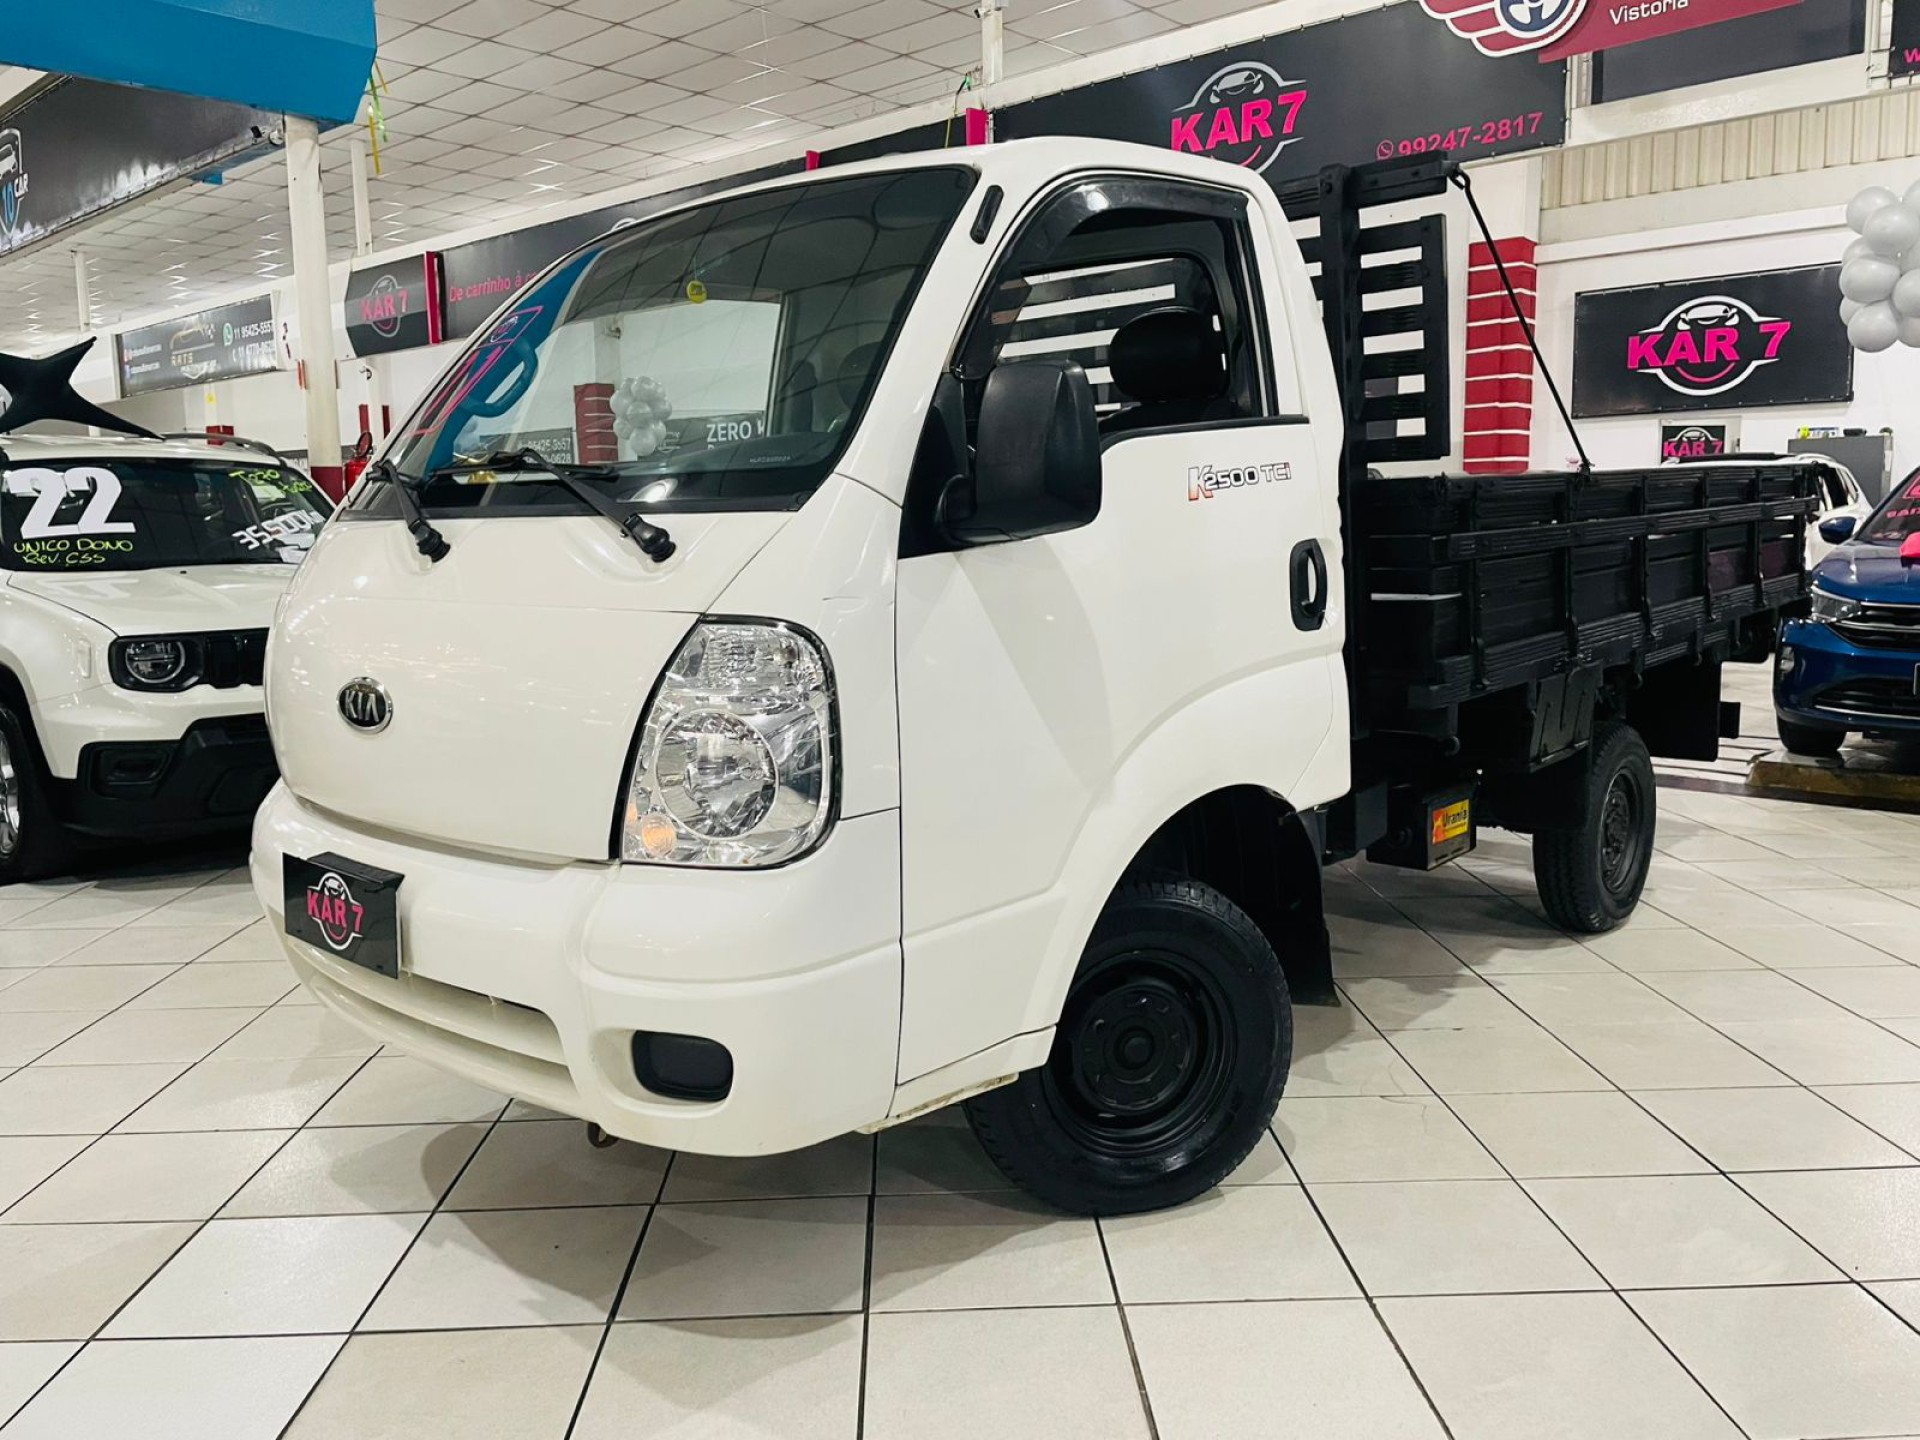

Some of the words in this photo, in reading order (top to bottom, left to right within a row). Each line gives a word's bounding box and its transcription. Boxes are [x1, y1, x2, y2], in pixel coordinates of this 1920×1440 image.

[1609, 0, 1689, 25] Vistoria
[1398, 112, 1543, 155] 99247-2817
[360, 293, 395, 320] KAR
[400, 289, 409, 312] 7
[450, 286, 463, 302] De
[467, 276, 511, 299] carrinho
[1627, 327, 1740, 369] KAR
[1759, 321, 1791, 358] 7
[706, 421, 752, 442] ZERO
[1663, 441, 1706, 457] KAR
[1711, 441, 1723, 455] 7
[7, 467, 136, 539] 22
[14, 541, 70, 554] UNICO
[77, 538, 133, 551] DONO
[344, 689, 381, 722] KIA
[306, 889, 348, 928] KAR
[351, 904, 365, 934] 7
